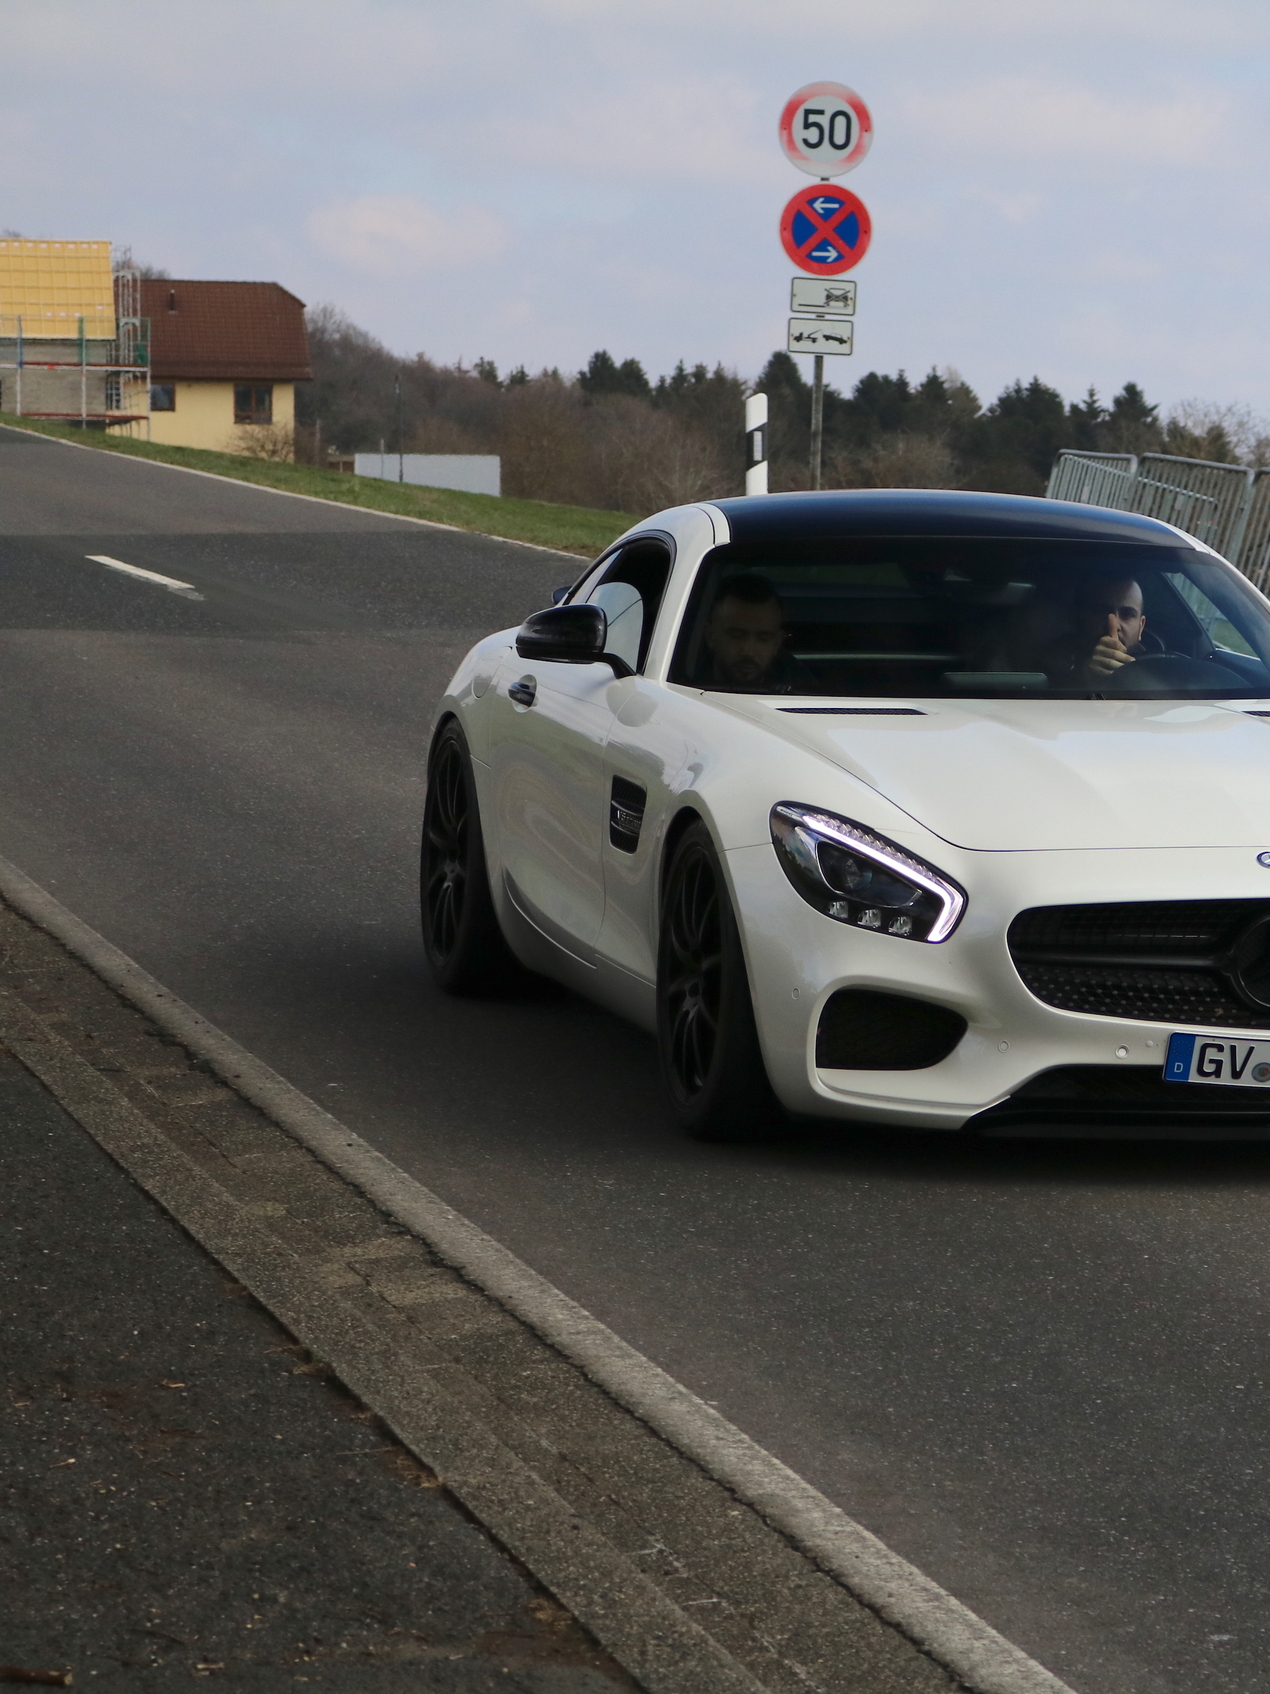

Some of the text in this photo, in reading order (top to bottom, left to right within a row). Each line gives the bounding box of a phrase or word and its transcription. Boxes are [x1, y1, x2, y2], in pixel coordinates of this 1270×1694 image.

[801, 108, 852, 150] 50
[1173, 1062, 1184, 1073] D
[1196, 1042, 1256, 1080] GV
